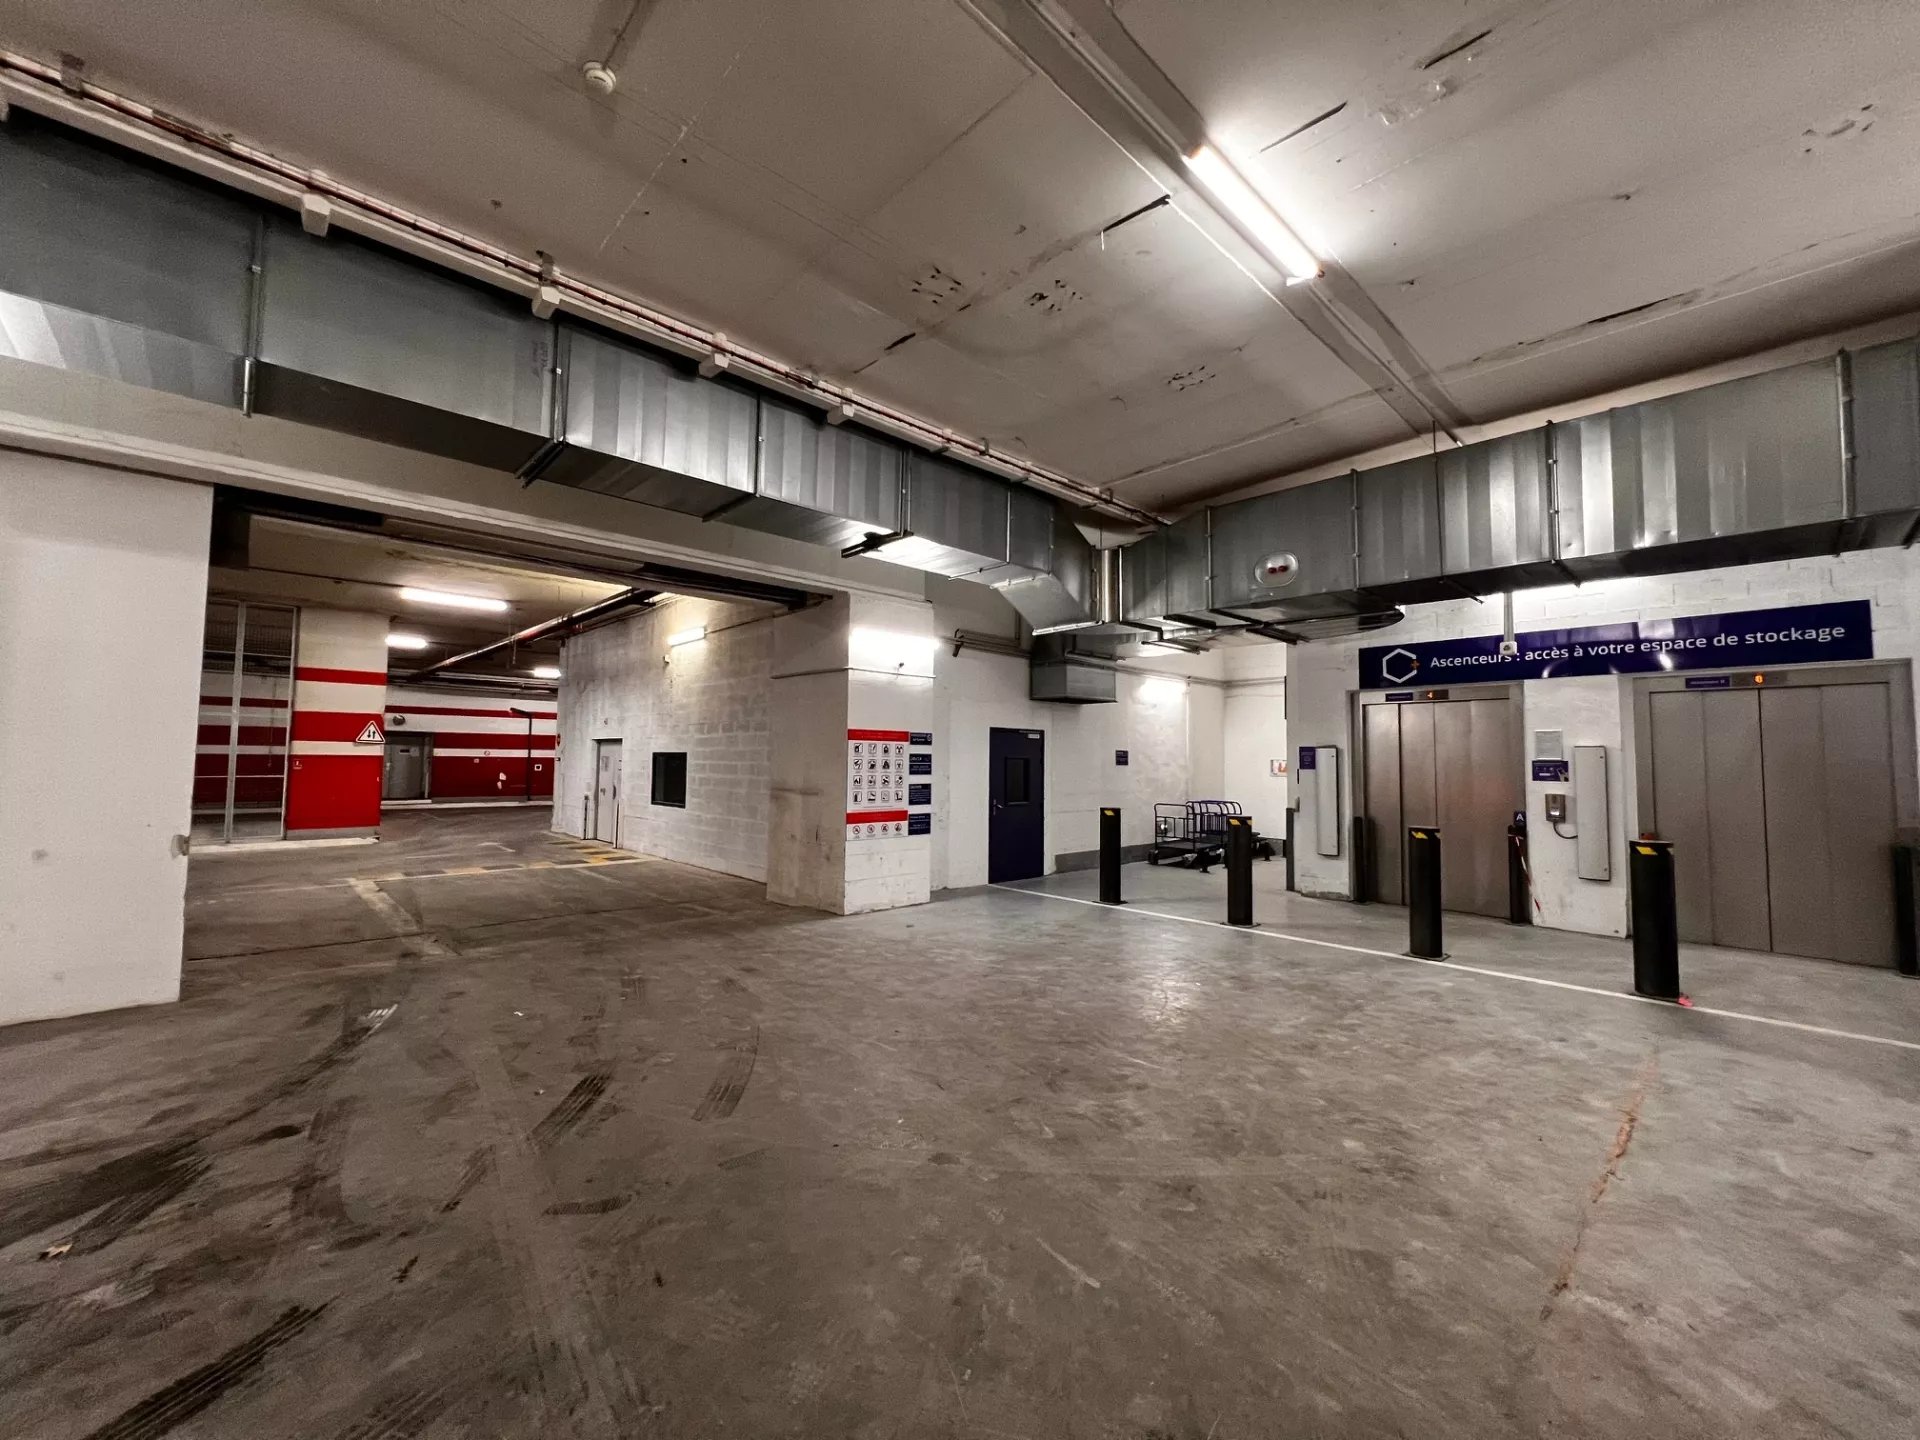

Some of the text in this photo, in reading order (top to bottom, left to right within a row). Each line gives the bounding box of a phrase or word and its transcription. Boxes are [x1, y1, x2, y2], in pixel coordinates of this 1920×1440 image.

[1525, 647, 1568, 660] accès
[1573, 645, 1583, 657] à
[1588, 642, 1635, 656] votre
[1640, 637, 1707, 654] espace
[1713, 633, 1739, 646] de
[1745, 626, 1846, 644] stockage
[1516, 813, 1524, 821] A
